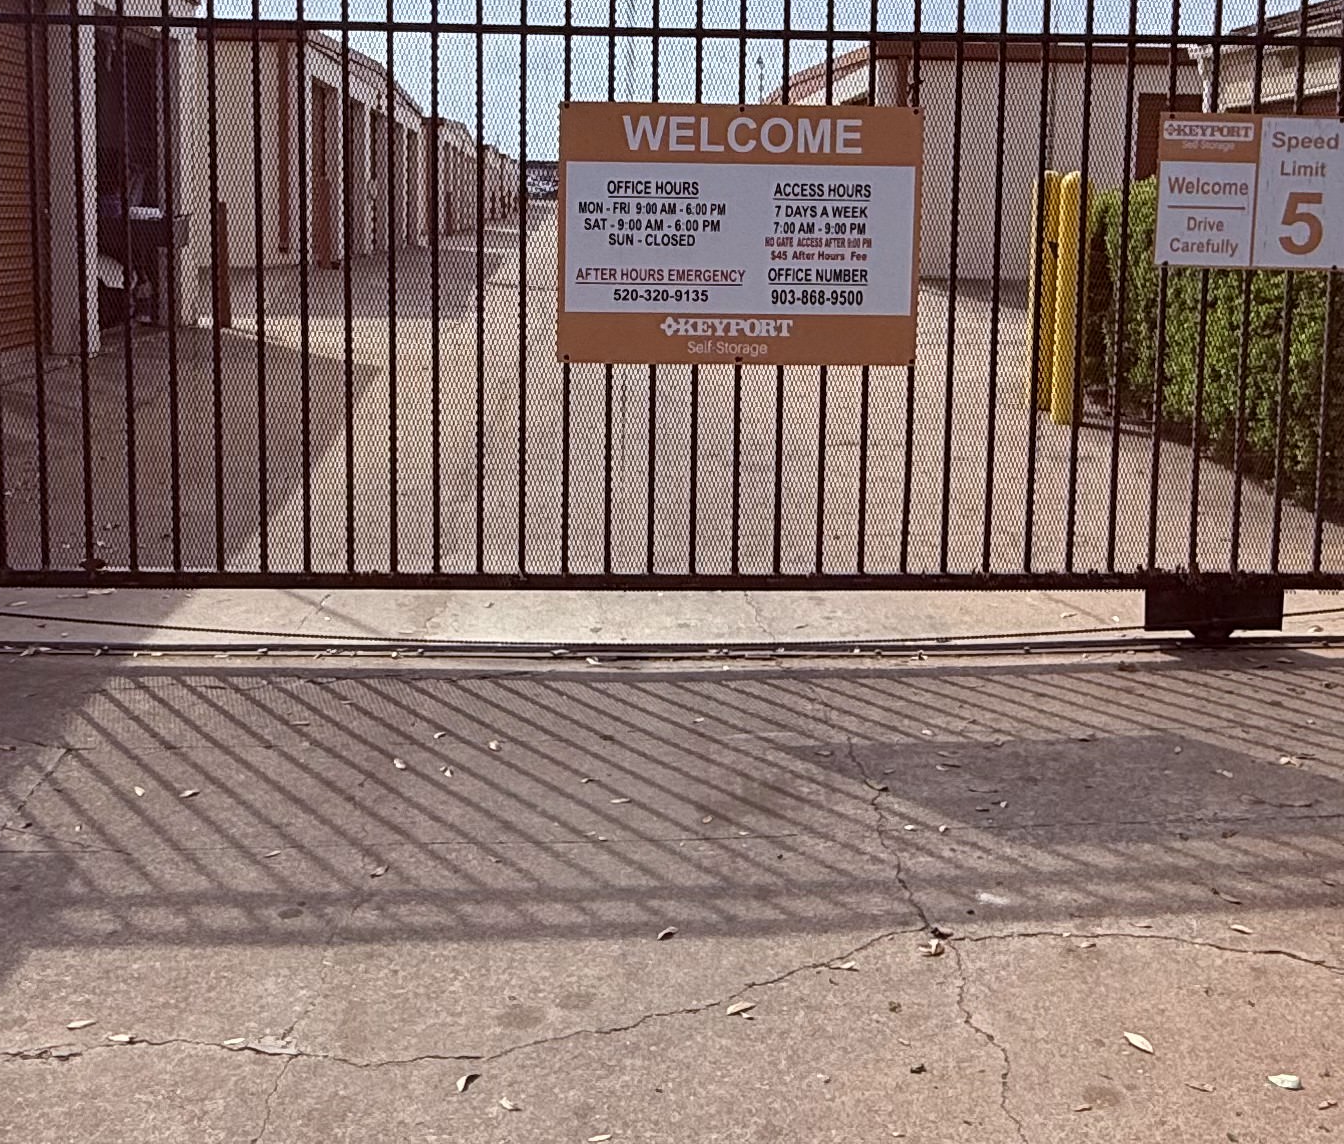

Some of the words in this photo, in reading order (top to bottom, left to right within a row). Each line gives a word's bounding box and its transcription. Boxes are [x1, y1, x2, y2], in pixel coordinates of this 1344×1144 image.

[623, 115, 863, 154] WELCOME
[1176, 124, 1253, 138] KEYPORT
[1272, 131, 1340, 152] Speed
[1280, 160, 1327, 178] Limit
[607, 180, 652, 195] OFFICE
[656, 181, 699, 196] HOURS
[774, 182, 825, 197] ACCESS
[828, 183, 872, 198] HOURS
[1168, 176, 1249, 196] Welcome
[578, 201, 603, 214] MON
[612, 202, 630, 214] FRI
[635, 202, 657, 215] 9:00
[660, 202, 677, 215] AM
[685, 203, 707, 216] 6:00
[710, 203, 726, 216] PM
[774, 205, 781, 217] 7
[785, 205, 817, 217] DAYS
[820, 205, 830, 218] A
[832, 206, 868, 219] WEEK
[584, 217, 608, 231] SAT
[617, 218, 642, 231] 9:00
[645, 218, 664, 231] AM
[674, 219, 699, 232] 6:00
[702, 219, 721, 232] PM
[773, 221, 796, 235] 7:00
[798, 222, 815, 235] AM
[824, 222, 847, 235] 9:00
[849, 222, 866, 236] PM
[1187, 216, 1225, 232] Drive
[1278, 192, 1324, 256] 5
[608, 233, 634, 246] SUN
[645, 233, 696, 247] CLOSED
[776, 237, 794, 248] GATE
[797, 237, 823, 248] ACCESS
[824, 237, 846, 249] AFTER
[1169, 237, 1239, 258] Carefully
[771, 250, 788, 261] $45
[792, 250, 815, 261] After
[818, 250, 845, 261] Hours
[850, 251, 868, 262] Fee
[575, 267, 618, 282] AFTER
[620, 268, 665, 282] HOURS
[668, 269, 746, 283] EMERGENCY
[767, 267, 813, 283] OFFICE
[815, 268, 868, 283] NUMBER
[613, 288, 709, 303] 520-320-9135
[770, 289, 864, 306] 903-868-9500
[677, 317, 794, 337] KEYPORT
